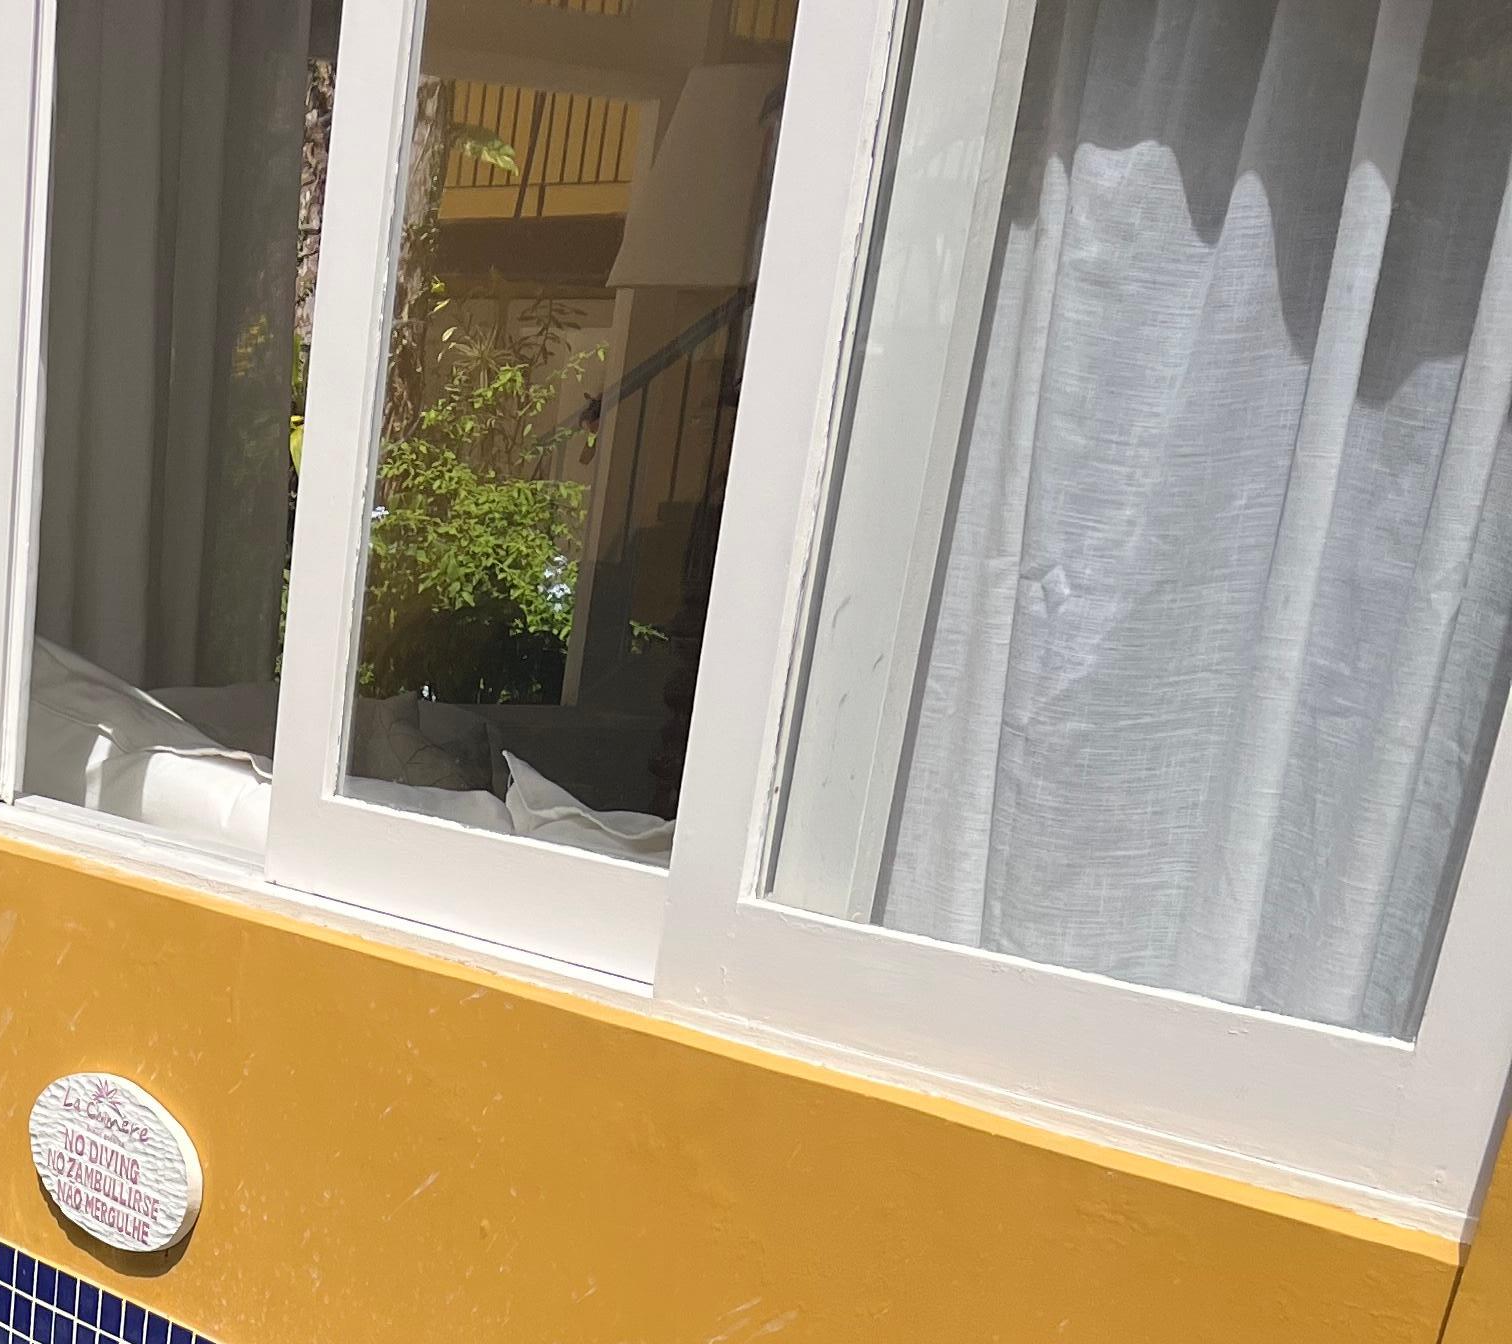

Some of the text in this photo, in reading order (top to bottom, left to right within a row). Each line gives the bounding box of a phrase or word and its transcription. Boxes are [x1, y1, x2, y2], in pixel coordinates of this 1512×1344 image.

[63, 1086, 82, 1113] La
[64, 1127, 86, 1157] NO
[89, 1140, 141, 1185] DIVING
[47, 1148, 161, 1222] NO ZAMBULLIRSE
[84, 1194, 152, 1246] MERGULHE
